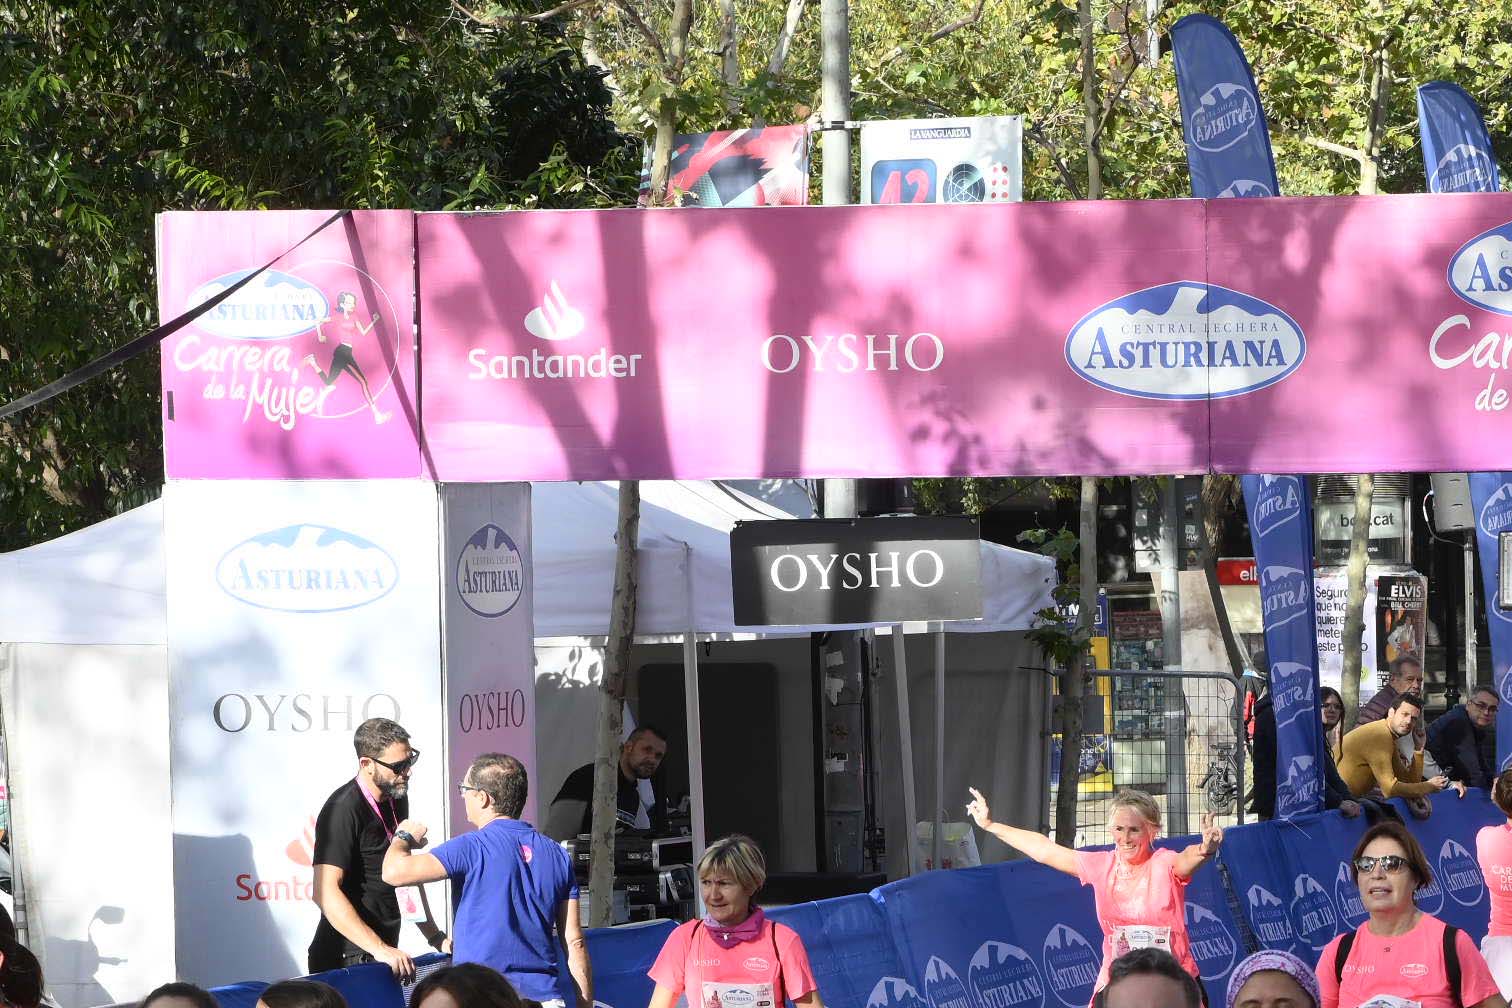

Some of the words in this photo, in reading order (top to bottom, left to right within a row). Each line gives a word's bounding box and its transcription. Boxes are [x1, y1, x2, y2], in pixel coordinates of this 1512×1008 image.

[920, 127, 970, 139] VANGUARDIA
[1122, 322, 1195, 335] CENTRAL
[1204, 321, 1279, 333] LECHERA
[174, 335, 291, 372] Carrera
[468, 347, 642, 380] Santander
[761, 333, 945, 374] OYSHO
[1084, 326, 1287, 370] ASTURIANA
[203, 377, 225, 401] de
[229, 371, 245, 400] la
[243, 367, 336, 431] Mujer
[1475, 374, 1508, 412] de
[231, 559, 386, 590] ASTURIANA
[462, 563, 520, 594] ASTURIANA
[771, 549, 944, 592] OYSHO
[1390, 585, 1421, 598] ELVIS
[213, 693, 401, 733] OYSHO
[459, 689, 526, 733] OYSHO
